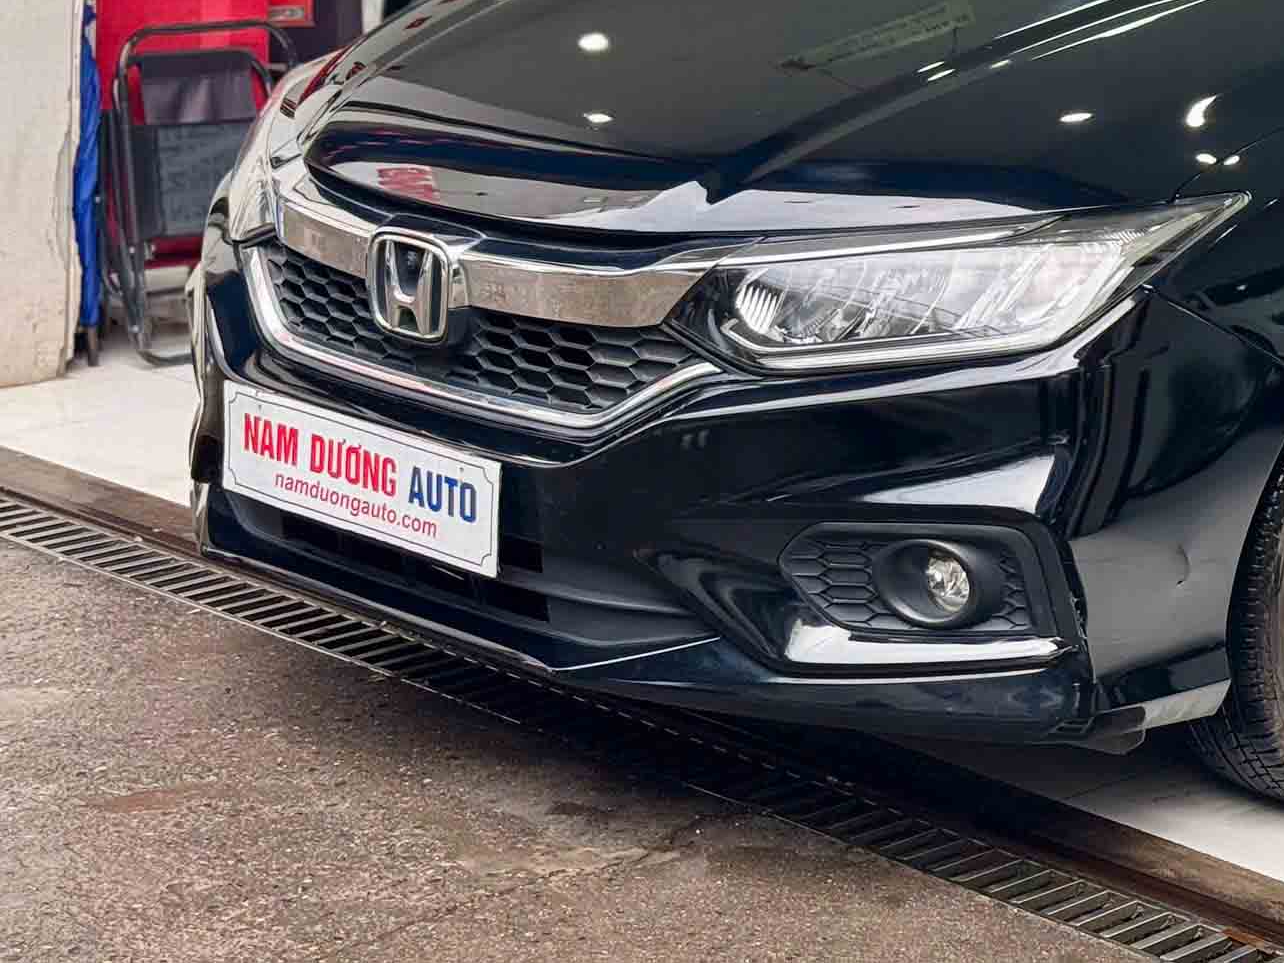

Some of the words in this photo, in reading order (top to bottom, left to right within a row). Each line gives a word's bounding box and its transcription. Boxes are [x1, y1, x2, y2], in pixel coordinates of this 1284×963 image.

[243, 412, 299, 467] NAM
[309, 431, 397, 498] DƯƠNG
[408, 466, 477, 524] AUTO
[275, 471, 437, 538] namduongauto.com
